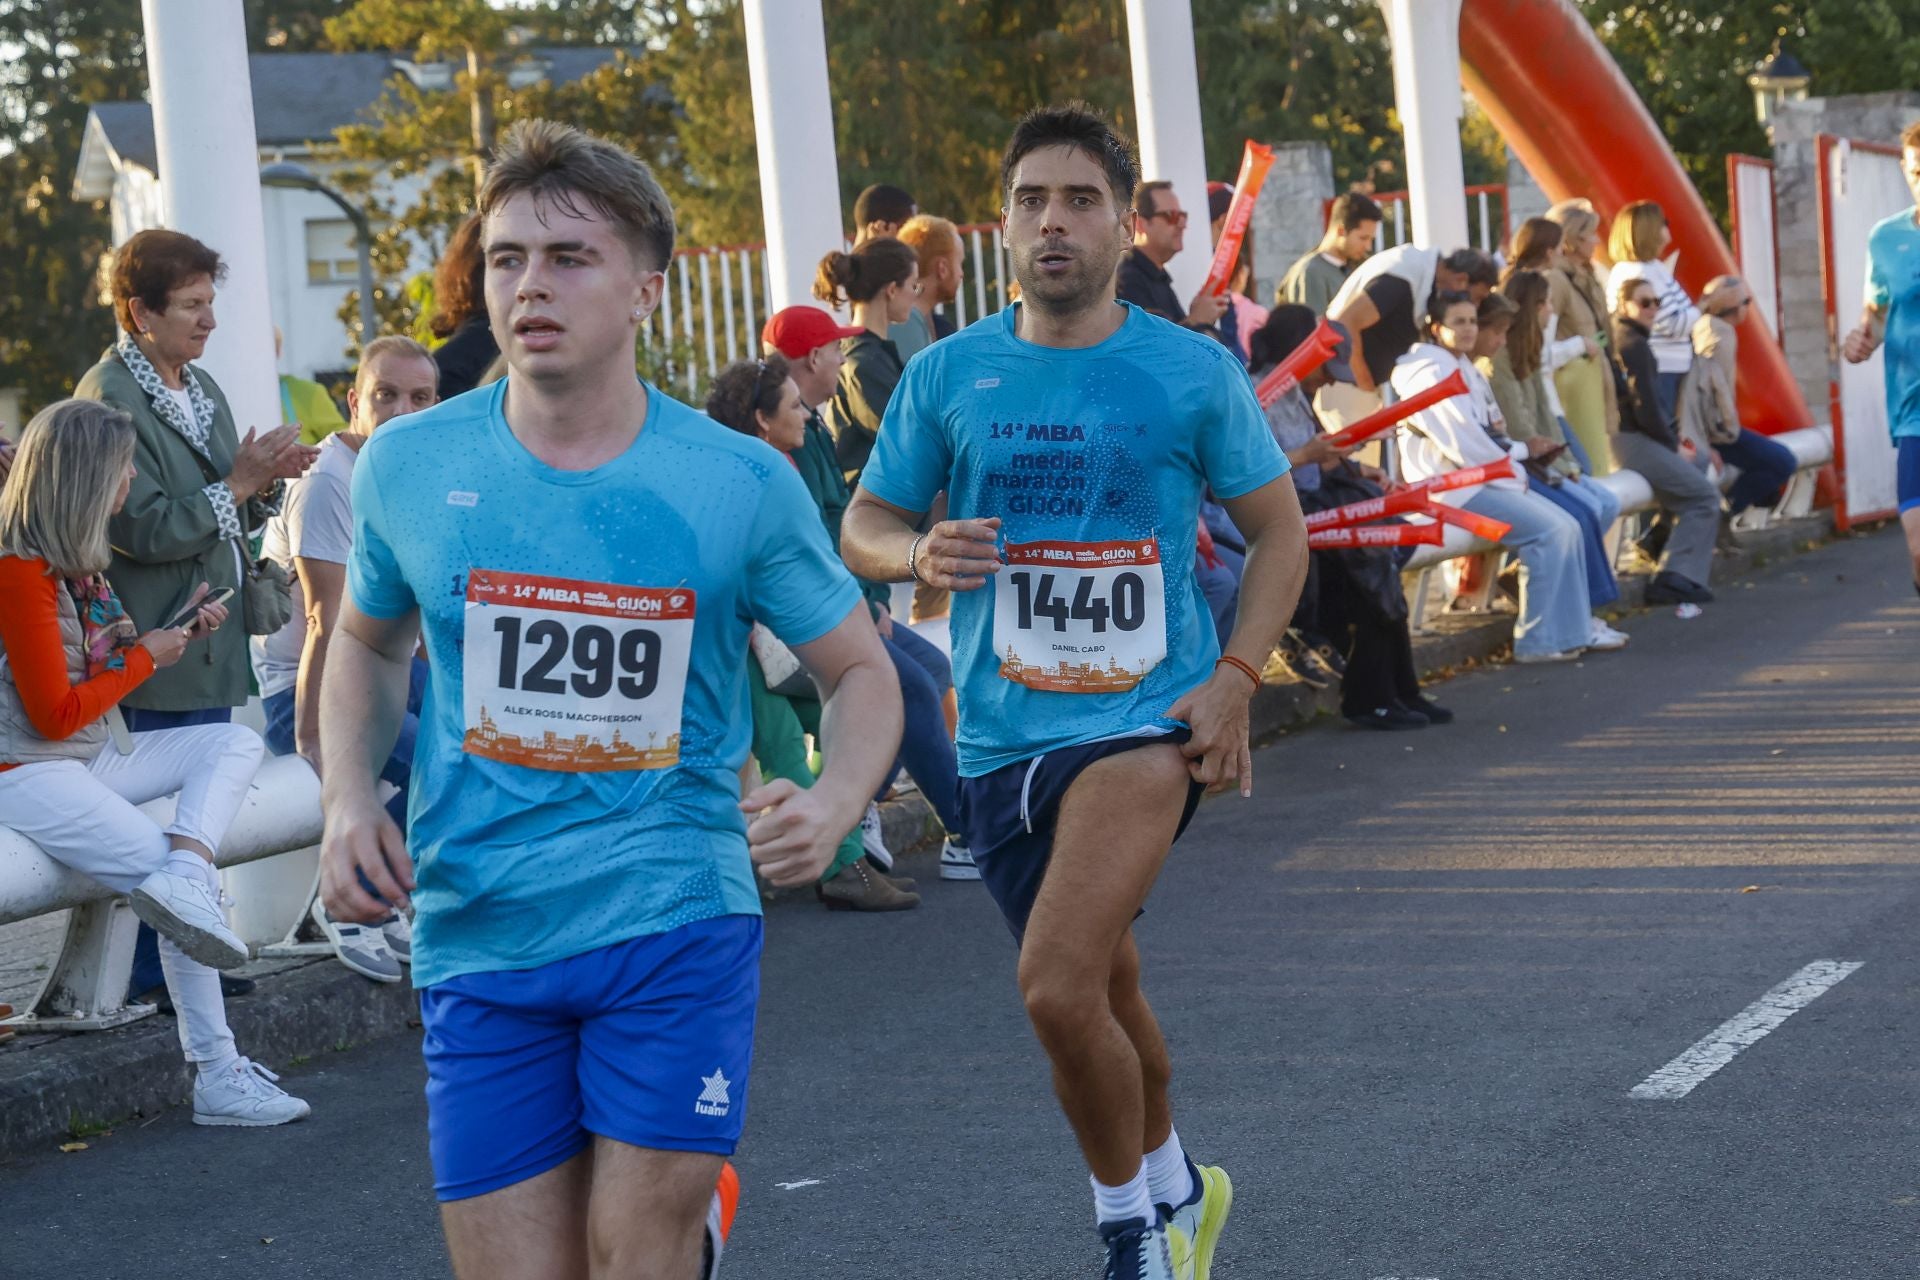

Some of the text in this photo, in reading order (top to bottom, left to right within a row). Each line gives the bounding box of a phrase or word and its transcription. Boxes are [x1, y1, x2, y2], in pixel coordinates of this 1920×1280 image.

[1026, 424, 1085, 442] MBA
[1011, 450, 1085, 471] media
[988, 471, 1085, 491] maratón
[1008, 494, 1084, 516] GIJÓN
[1043, 549, 1075, 561] MBA
[1102, 547, 1136, 560] GIJÓN
[537, 587, 581, 605] MBA
[616, 595, 662, 611] GIJÓN
[1010, 571, 1145, 633] 1440
[493, 615, 662, 700] 1299
[1052, 644, 1106, 653] DANIEL CABO
[504, 705, 642, 723] ALEX ROSS MACPHERSON
